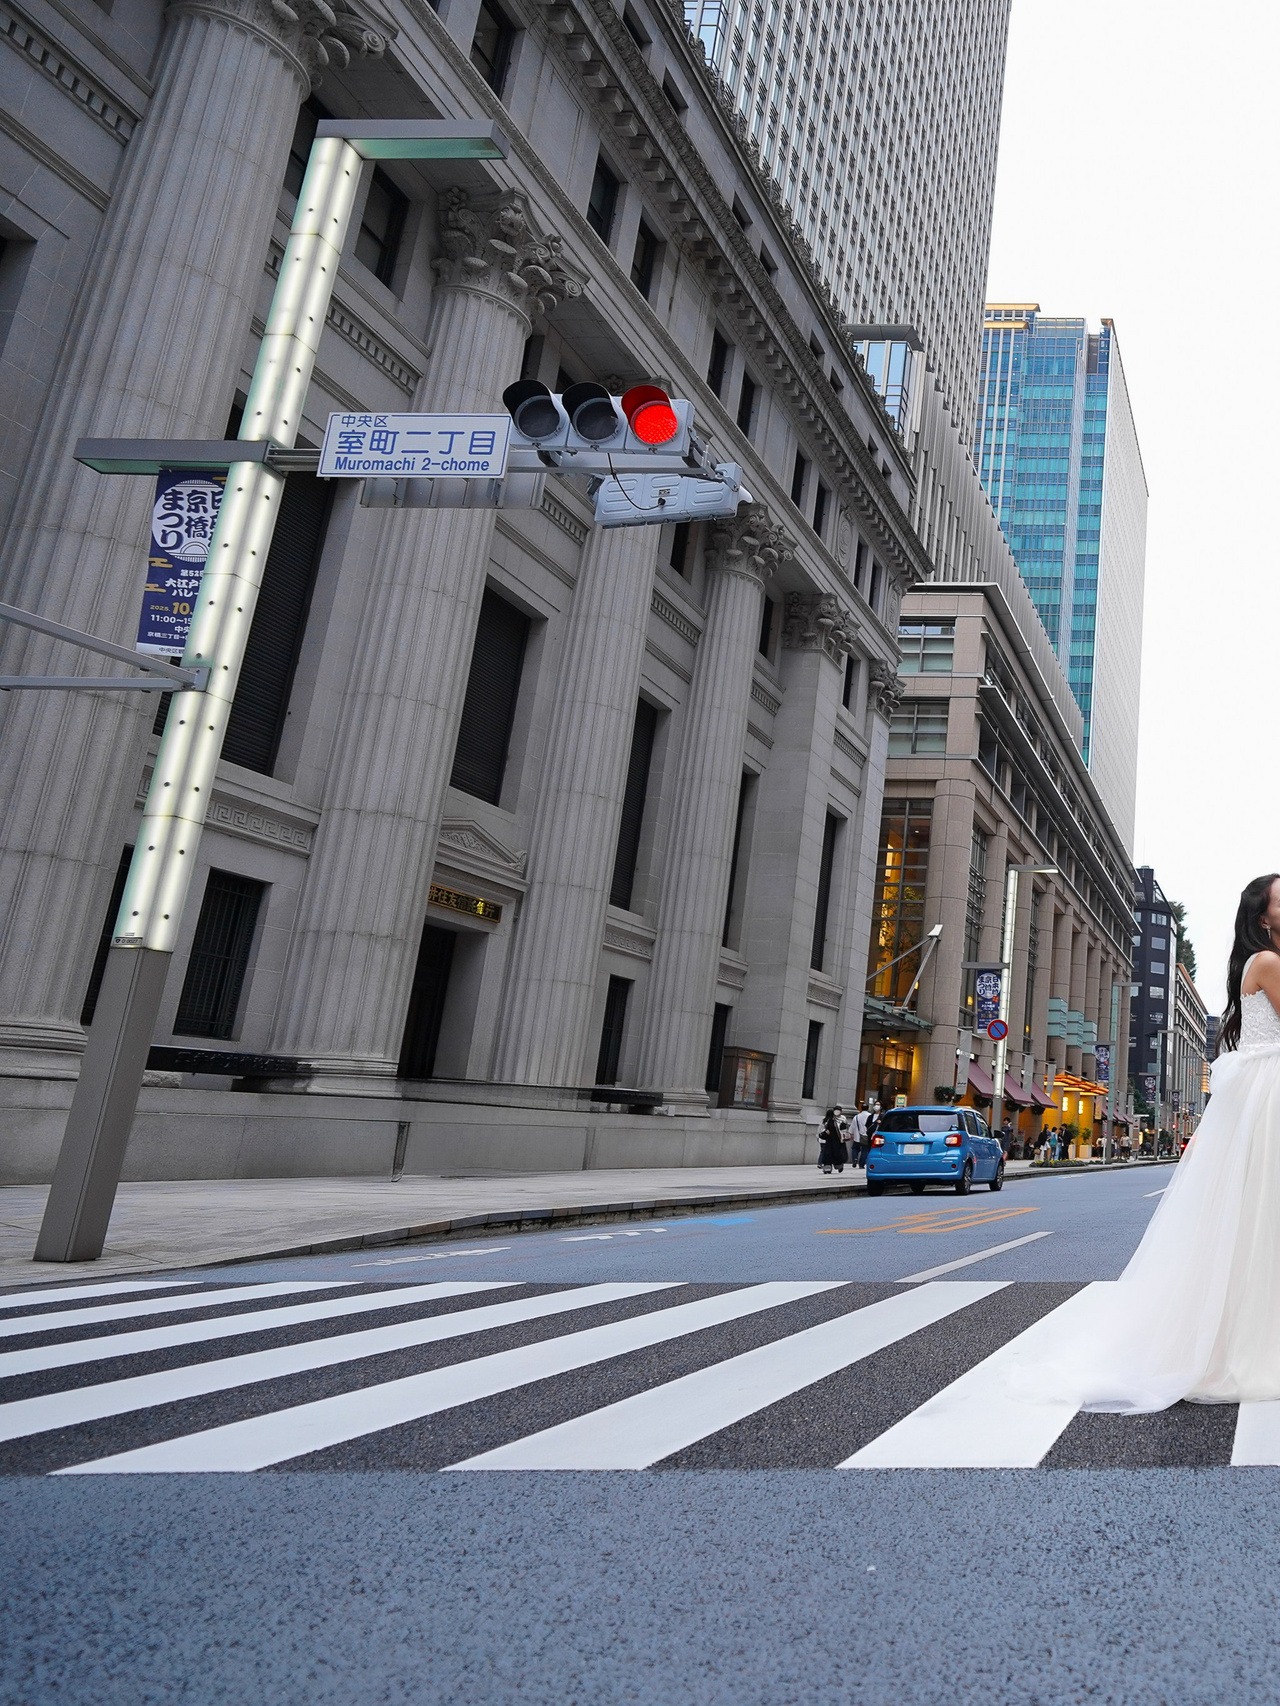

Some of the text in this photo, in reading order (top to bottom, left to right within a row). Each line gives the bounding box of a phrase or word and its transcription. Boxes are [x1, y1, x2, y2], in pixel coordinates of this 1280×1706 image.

[341, 415, 389, 428] 中央区
[335, 429, 497, 456] 室町二丁目
[334, 456, 490, 472] Muromachi 2-chome
[156, 488, 185, 551] まつり
[184, 490, 209, 539] 京橋
[165, 577, 202, 589] 大江戸
